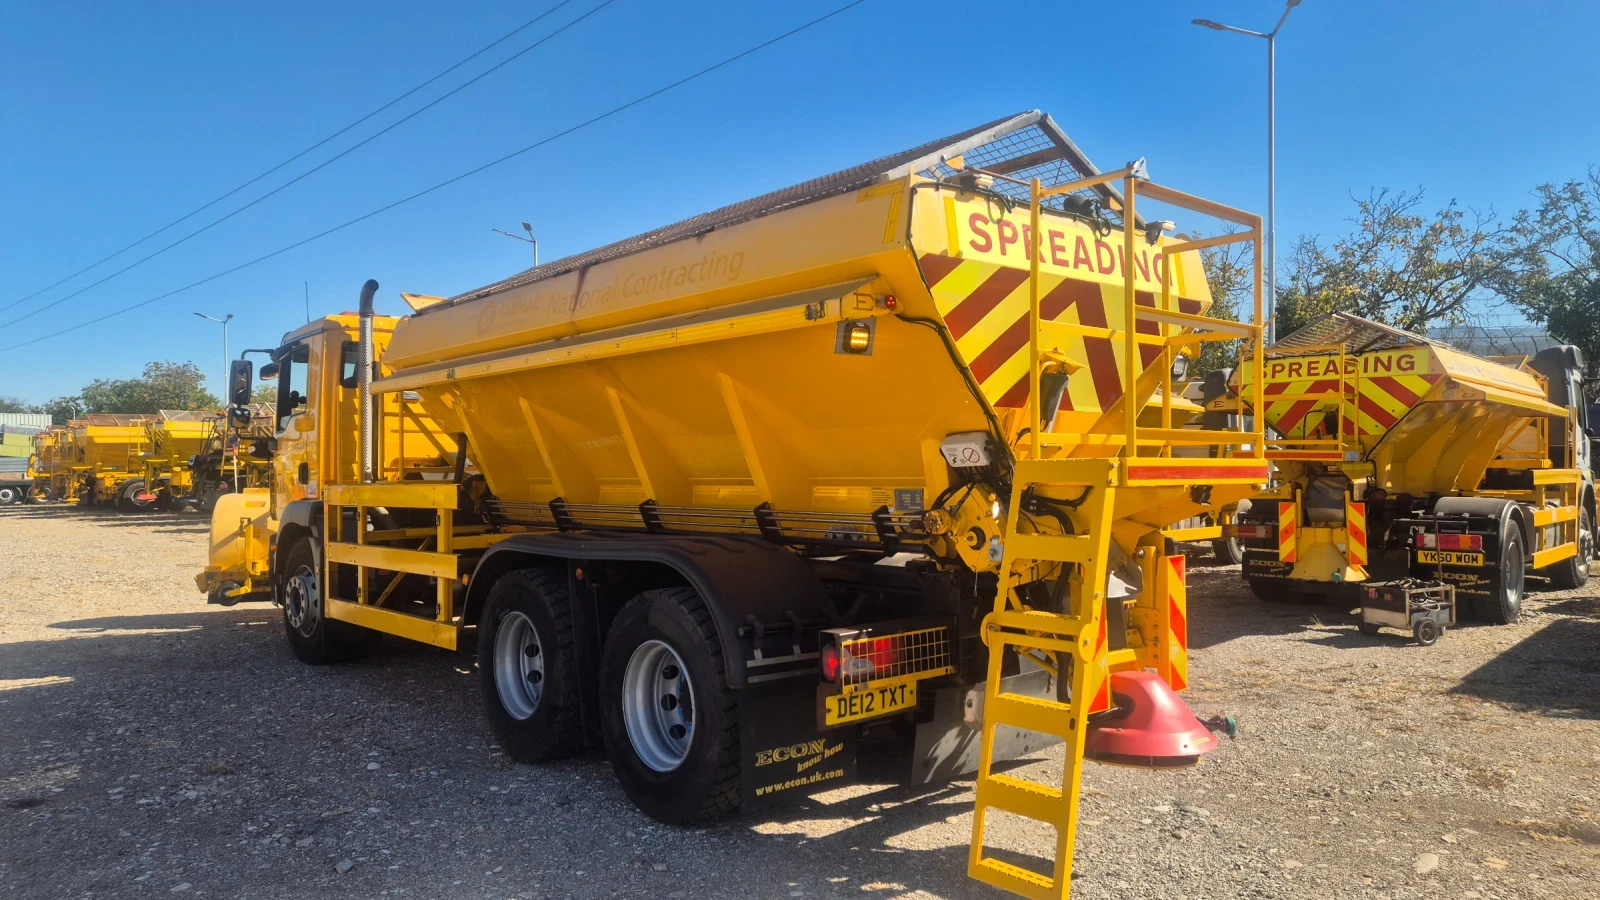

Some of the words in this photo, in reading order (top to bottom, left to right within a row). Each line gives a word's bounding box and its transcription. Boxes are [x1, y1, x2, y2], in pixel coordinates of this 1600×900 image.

[622, 249, 744, 298] Contracting
[837, 692, 874, 718] DE12
[879, 684, 907, 709] TXT
[755, 739, 826, 767] ECON
[797, 754, 822, 773] know
[824, 742, 844, 759] how
[755, 769, 844, 797] www.econ.uk.com
